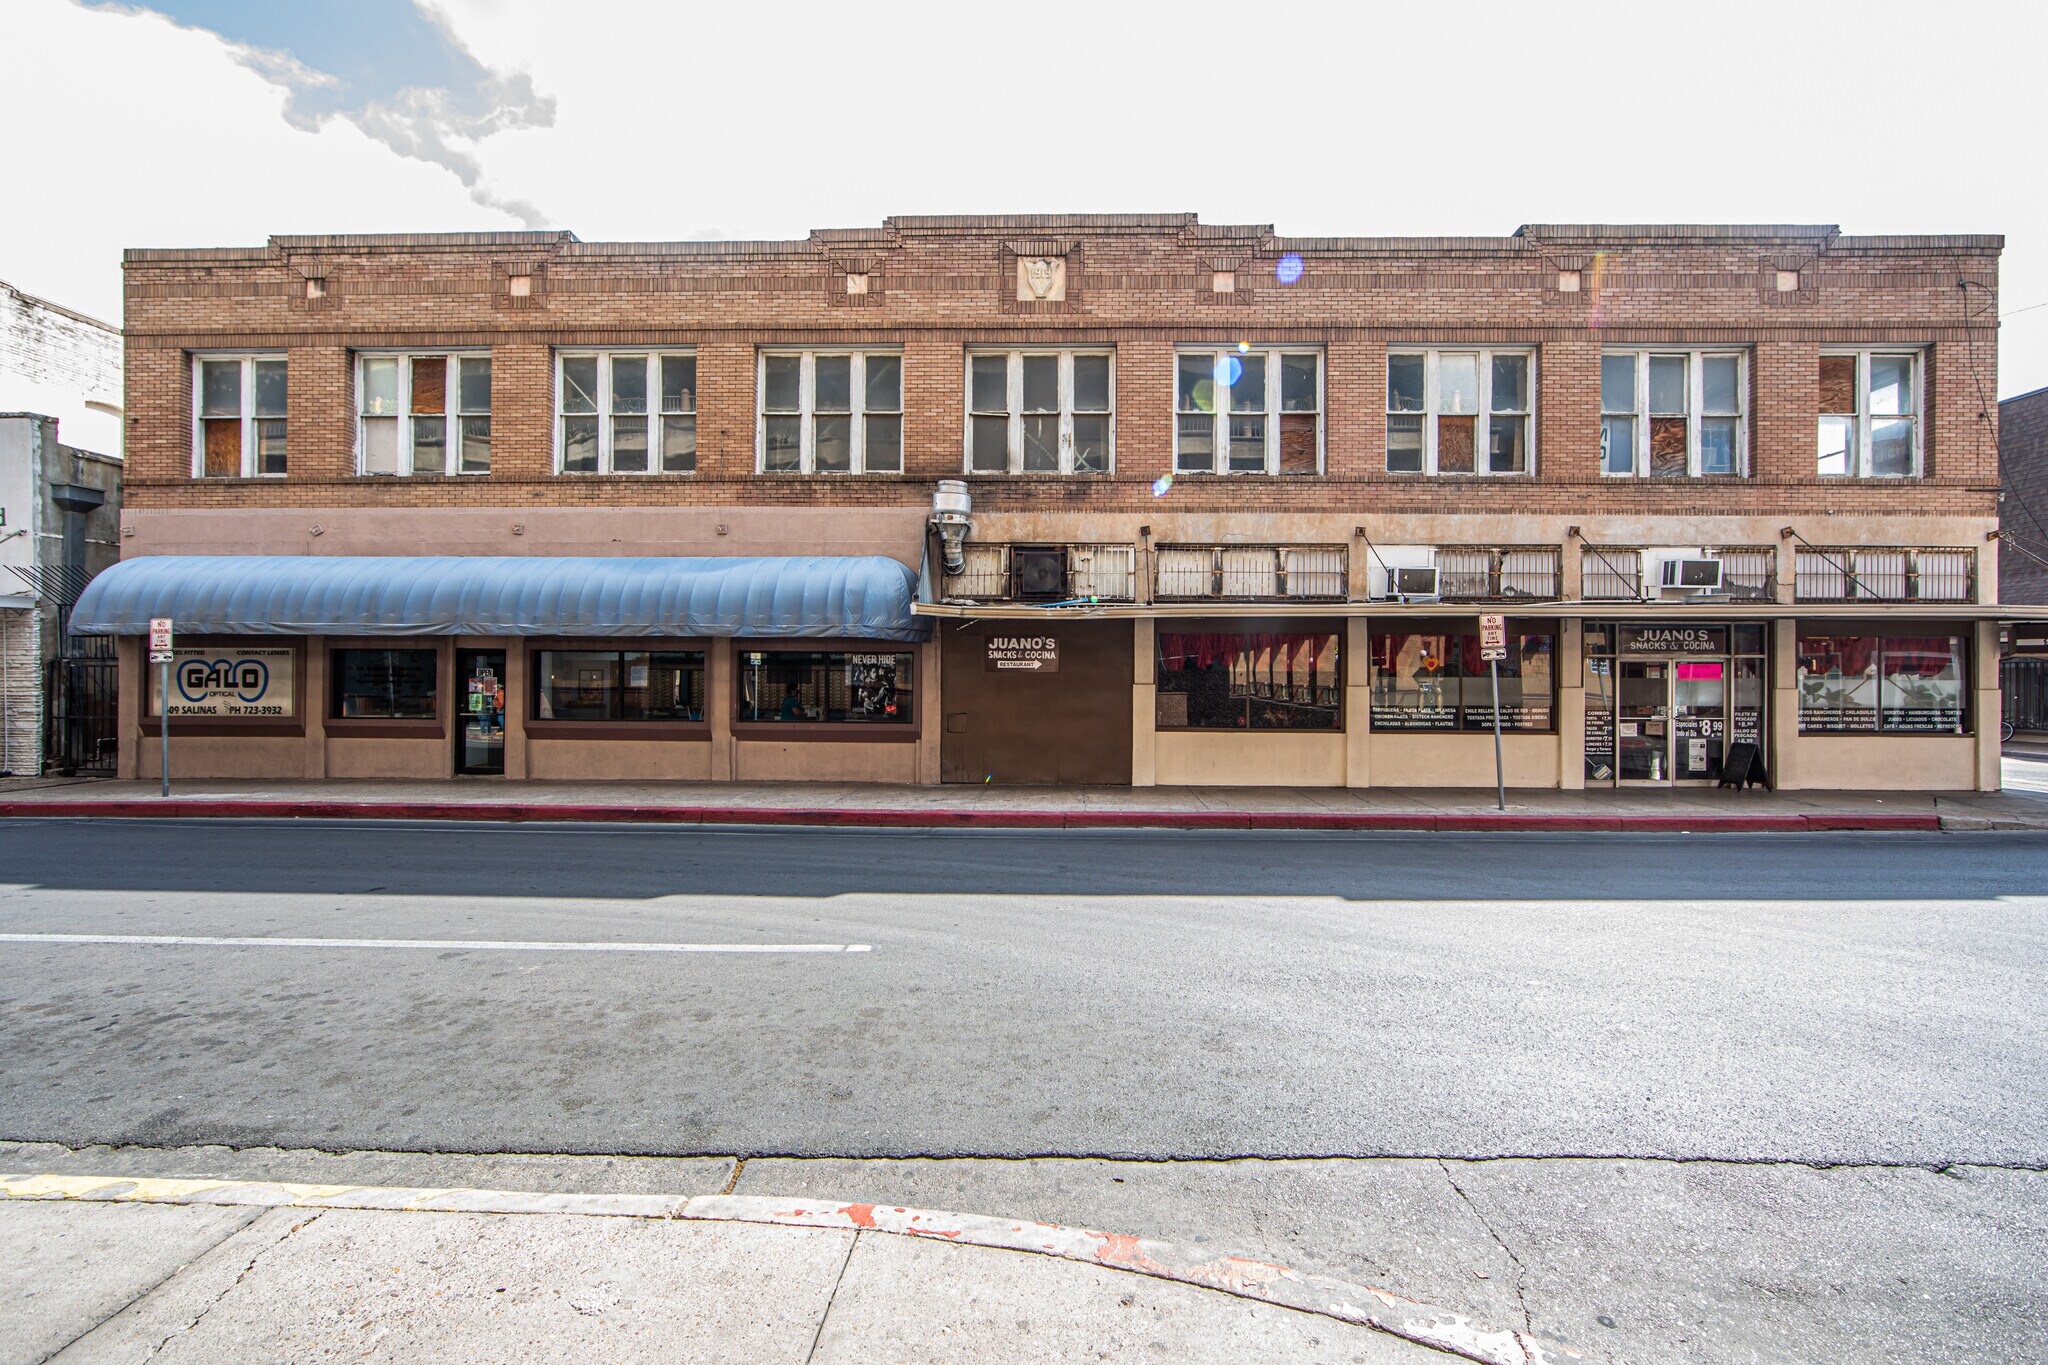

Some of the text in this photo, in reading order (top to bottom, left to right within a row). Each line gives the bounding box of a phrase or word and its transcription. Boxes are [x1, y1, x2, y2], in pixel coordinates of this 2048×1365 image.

[989, 636, 1055, 649] JUANO'S
[1630, 642, 1715, 650] SNACKS & COCINA
[988, 650, 1056, 659] SNACKS & COCINA
[852, 655, 896, 664] NEVER HIDE
[187, 669, 258, 688] GALO
[168, 706, 217, 714] 09 SALINAS
[229, 706, 282, 714] PH 723-3932
